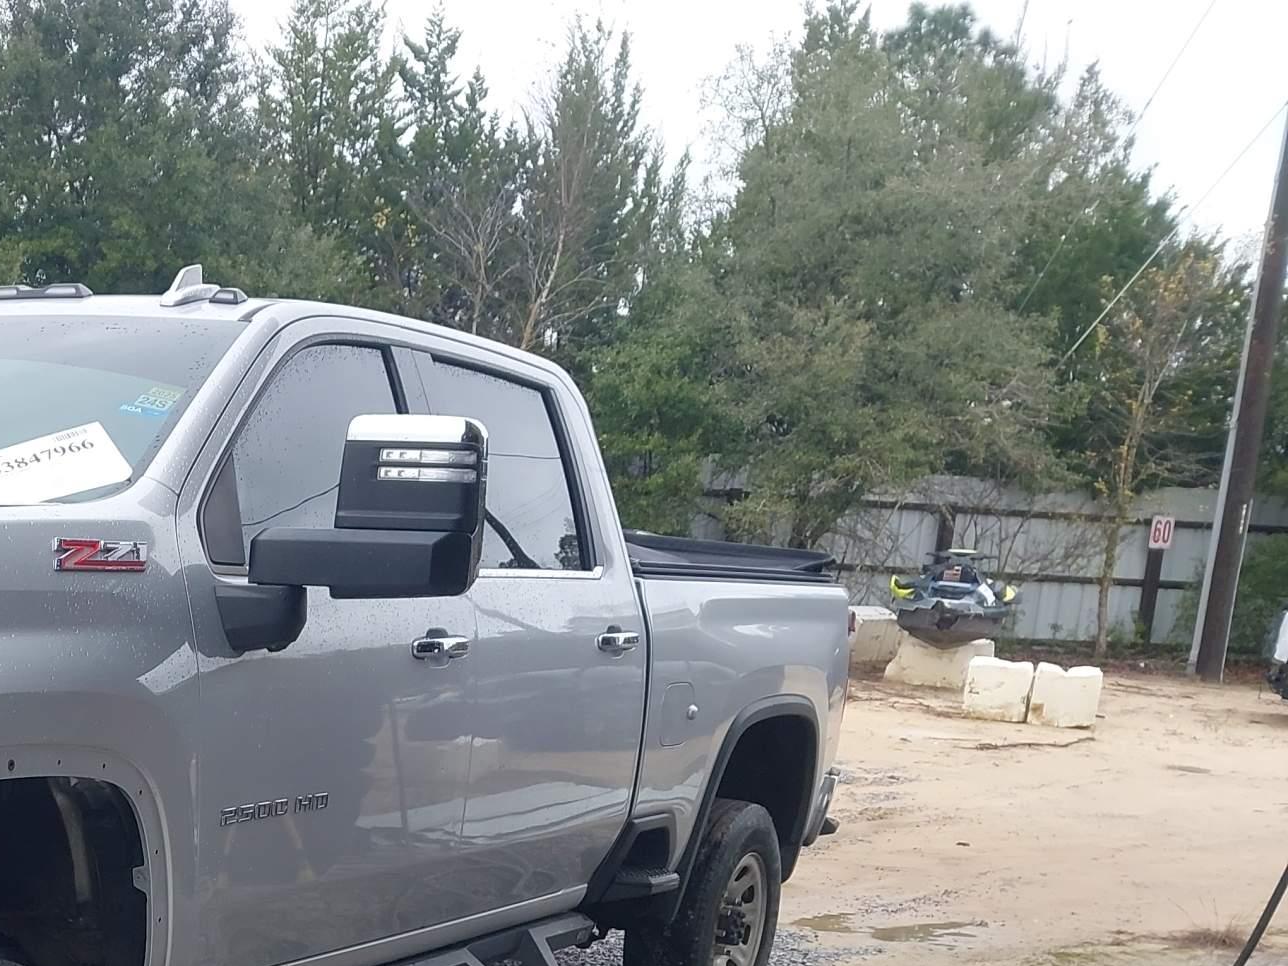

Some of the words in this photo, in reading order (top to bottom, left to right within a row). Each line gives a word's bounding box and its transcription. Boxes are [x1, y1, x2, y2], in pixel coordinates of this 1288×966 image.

[1152, 519, 1172, 544] 60
[53, 536, 148, 573] Z71
[219, 798, 289, 827] 2500
[294, 791, 329, 815] HD
